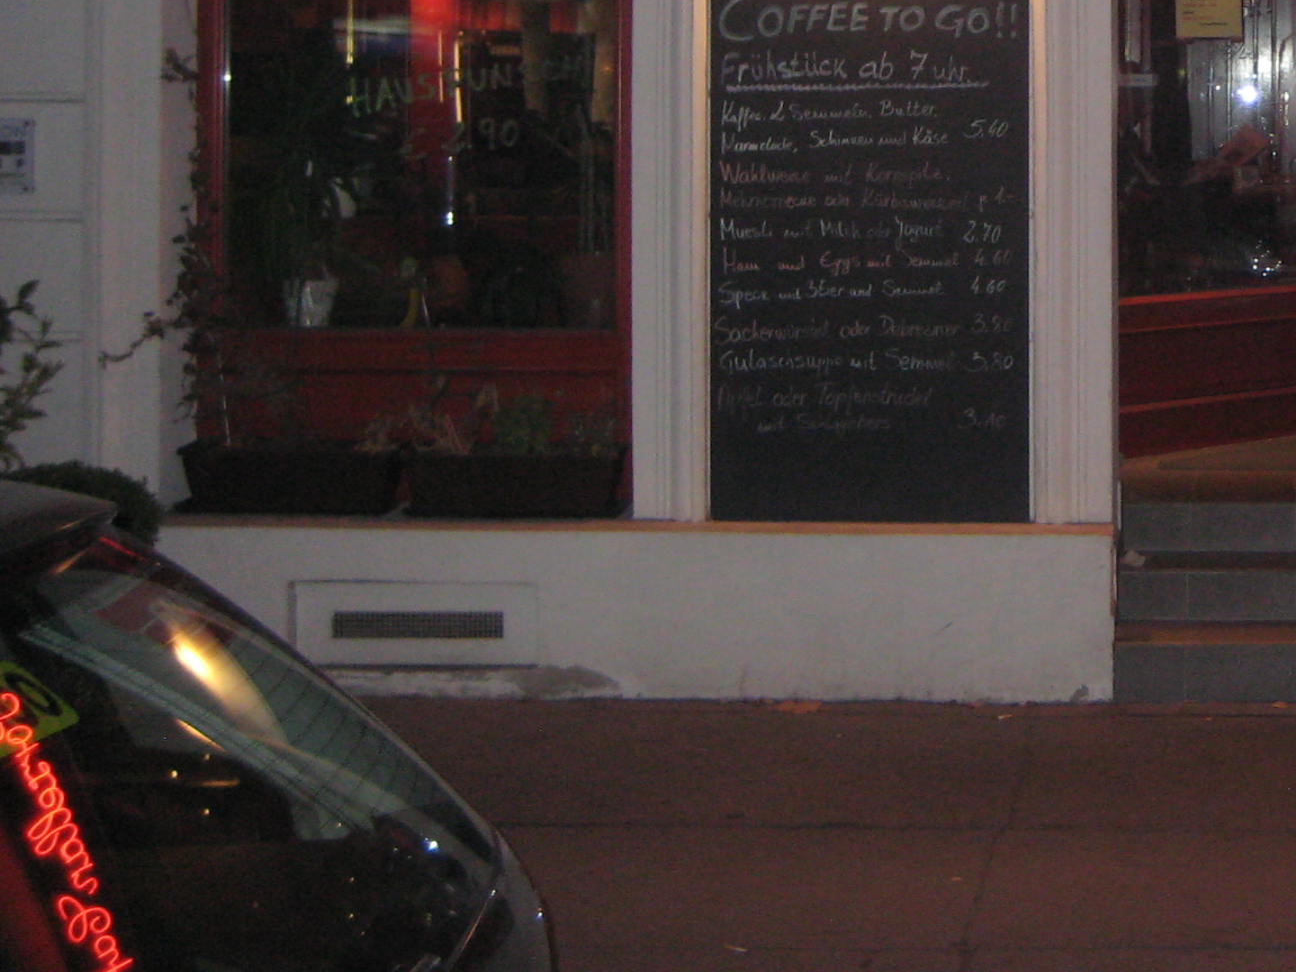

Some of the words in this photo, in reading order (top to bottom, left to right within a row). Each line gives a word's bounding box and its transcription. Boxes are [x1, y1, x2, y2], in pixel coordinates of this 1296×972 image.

[878, 4, 925, 34] TO
[720, 44, 848, 82] Frühstück
[859, 51, 894, 80] ab
[910, 49, 929, 81] 7
